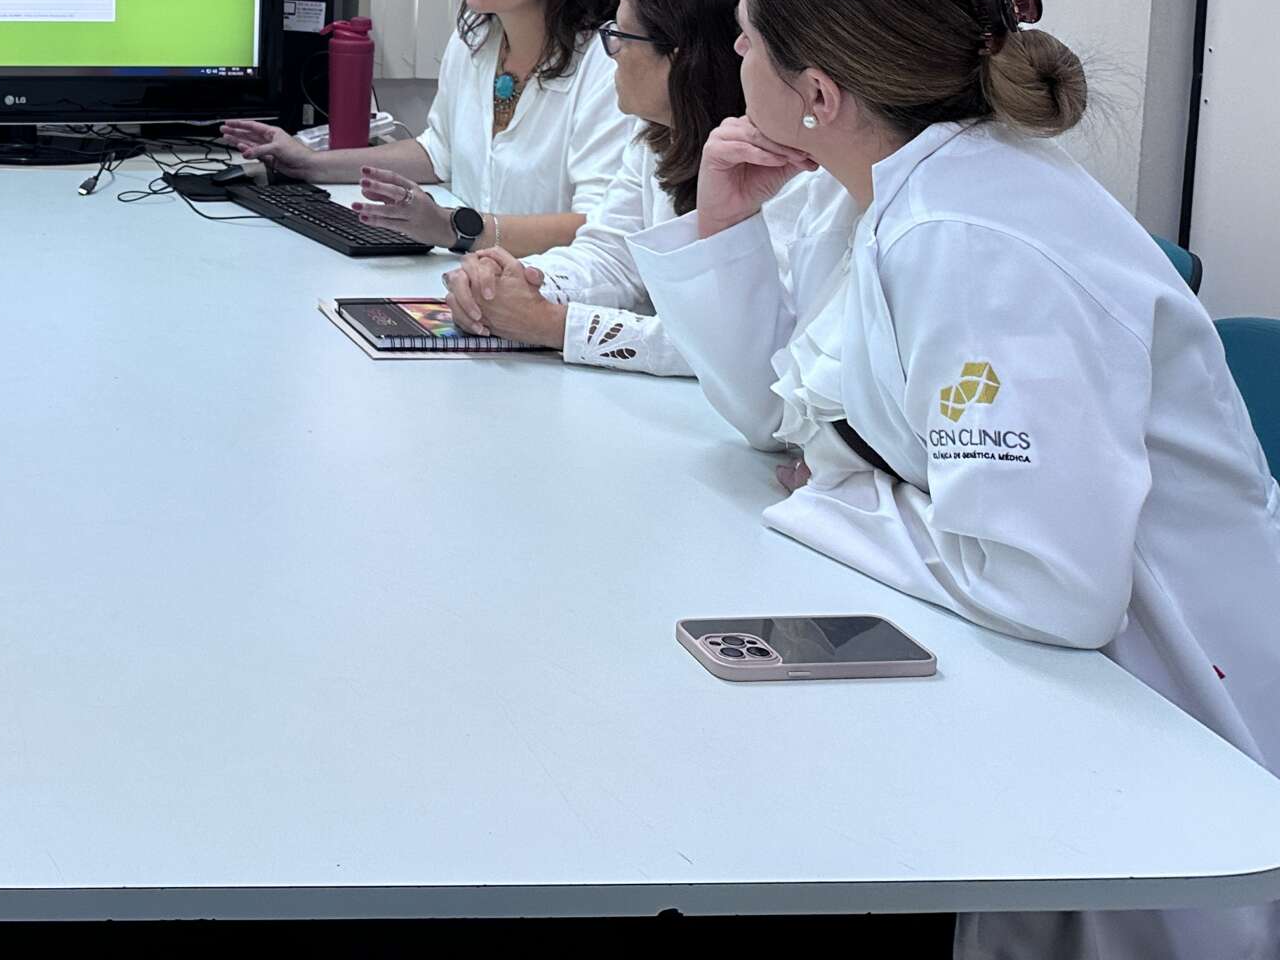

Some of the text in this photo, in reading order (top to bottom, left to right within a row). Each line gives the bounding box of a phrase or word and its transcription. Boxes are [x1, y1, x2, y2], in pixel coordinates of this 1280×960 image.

[15, 96, 28, 105] LG
[929, 428, 1031, 450] GEN CLINICS
[953, 452, 961, 460] DE
[998, 451, 1031, 463] MÉDICA
